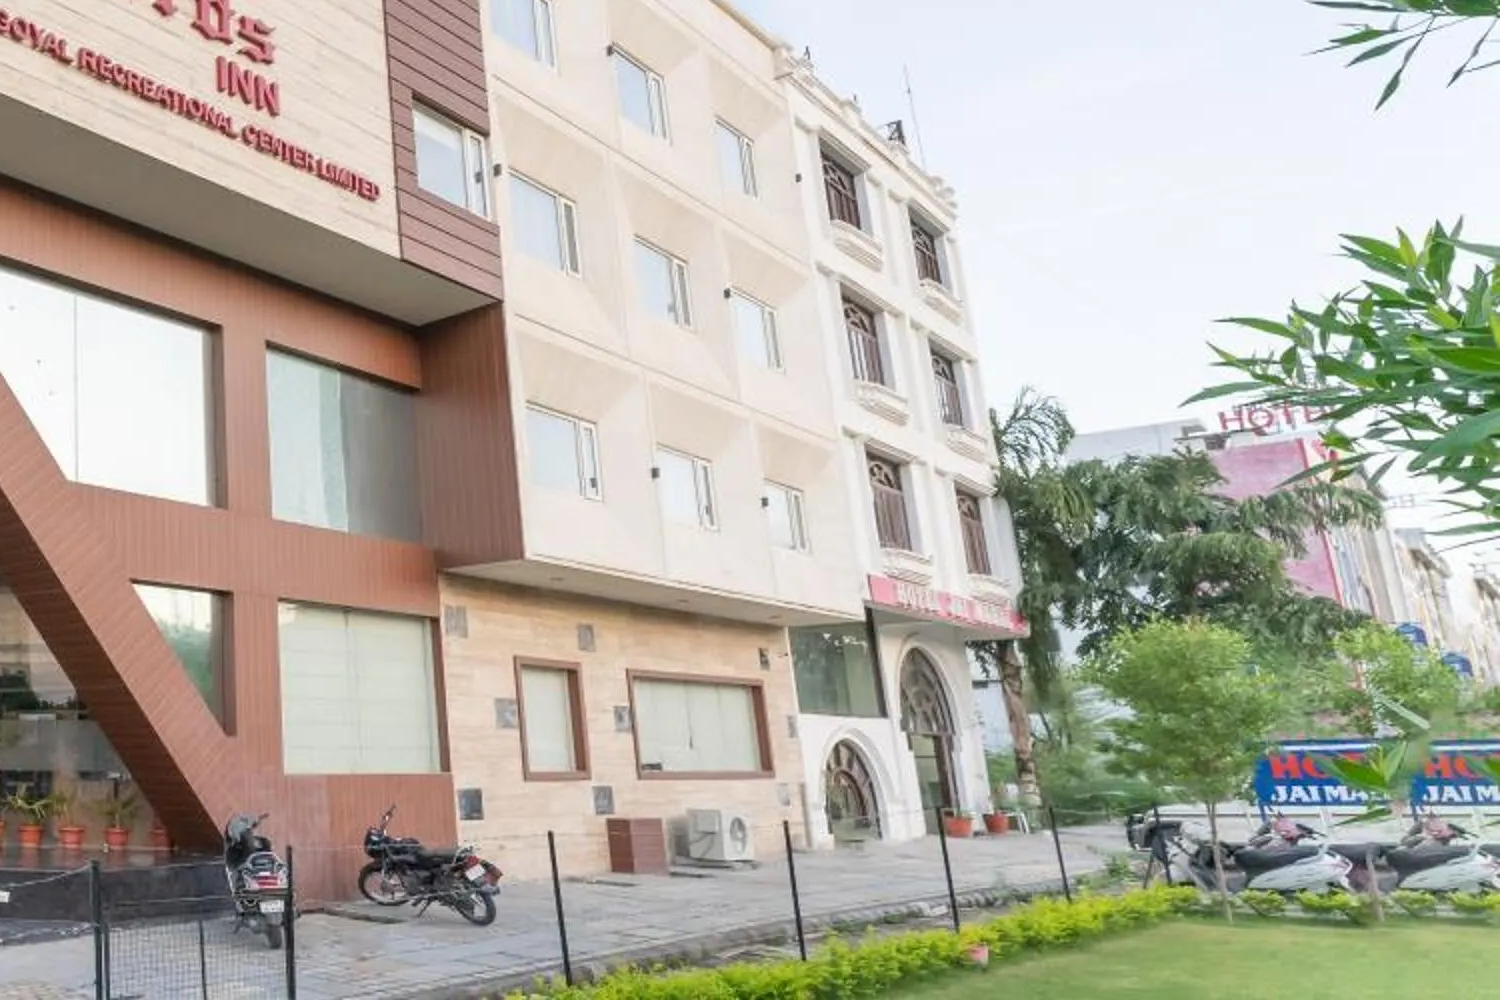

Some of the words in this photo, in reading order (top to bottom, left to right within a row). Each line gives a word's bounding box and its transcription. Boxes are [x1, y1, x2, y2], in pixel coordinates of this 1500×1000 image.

[78, 47, 238, 139] RECREATIONAL
[242, 122, 317, 174] CENTER
[315, 159, 382, 201] LIMITED
[215, 55, 281, 117] INN
